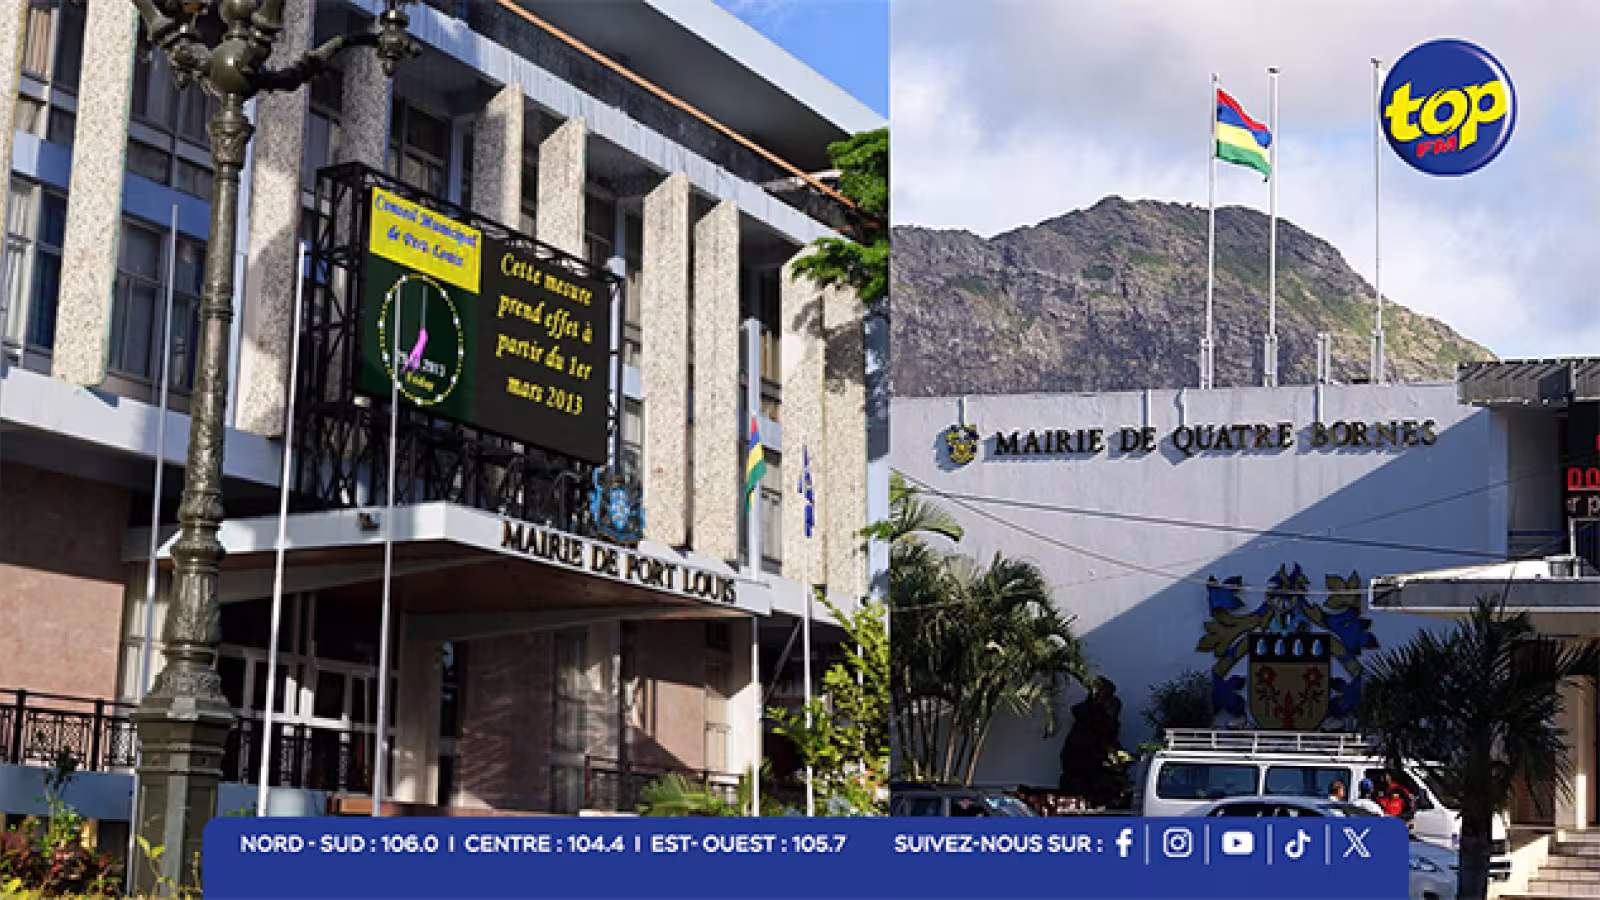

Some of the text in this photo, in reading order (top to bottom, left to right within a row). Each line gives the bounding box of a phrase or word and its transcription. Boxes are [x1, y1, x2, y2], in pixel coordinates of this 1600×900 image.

[500, 252, 593, 306] Cette mesure
[496, 295, 593, 344] prend effet à
[495, 333, 544, 362] partir
[543, 345, 565, 371] du
[506, 376, 583, 415] mars 2013
[994, 419, 1438, 458] MAIRIE DE QUATRE BORNES
[501, 519, 735, 604] MAIRIE DE PORT LOUIS
